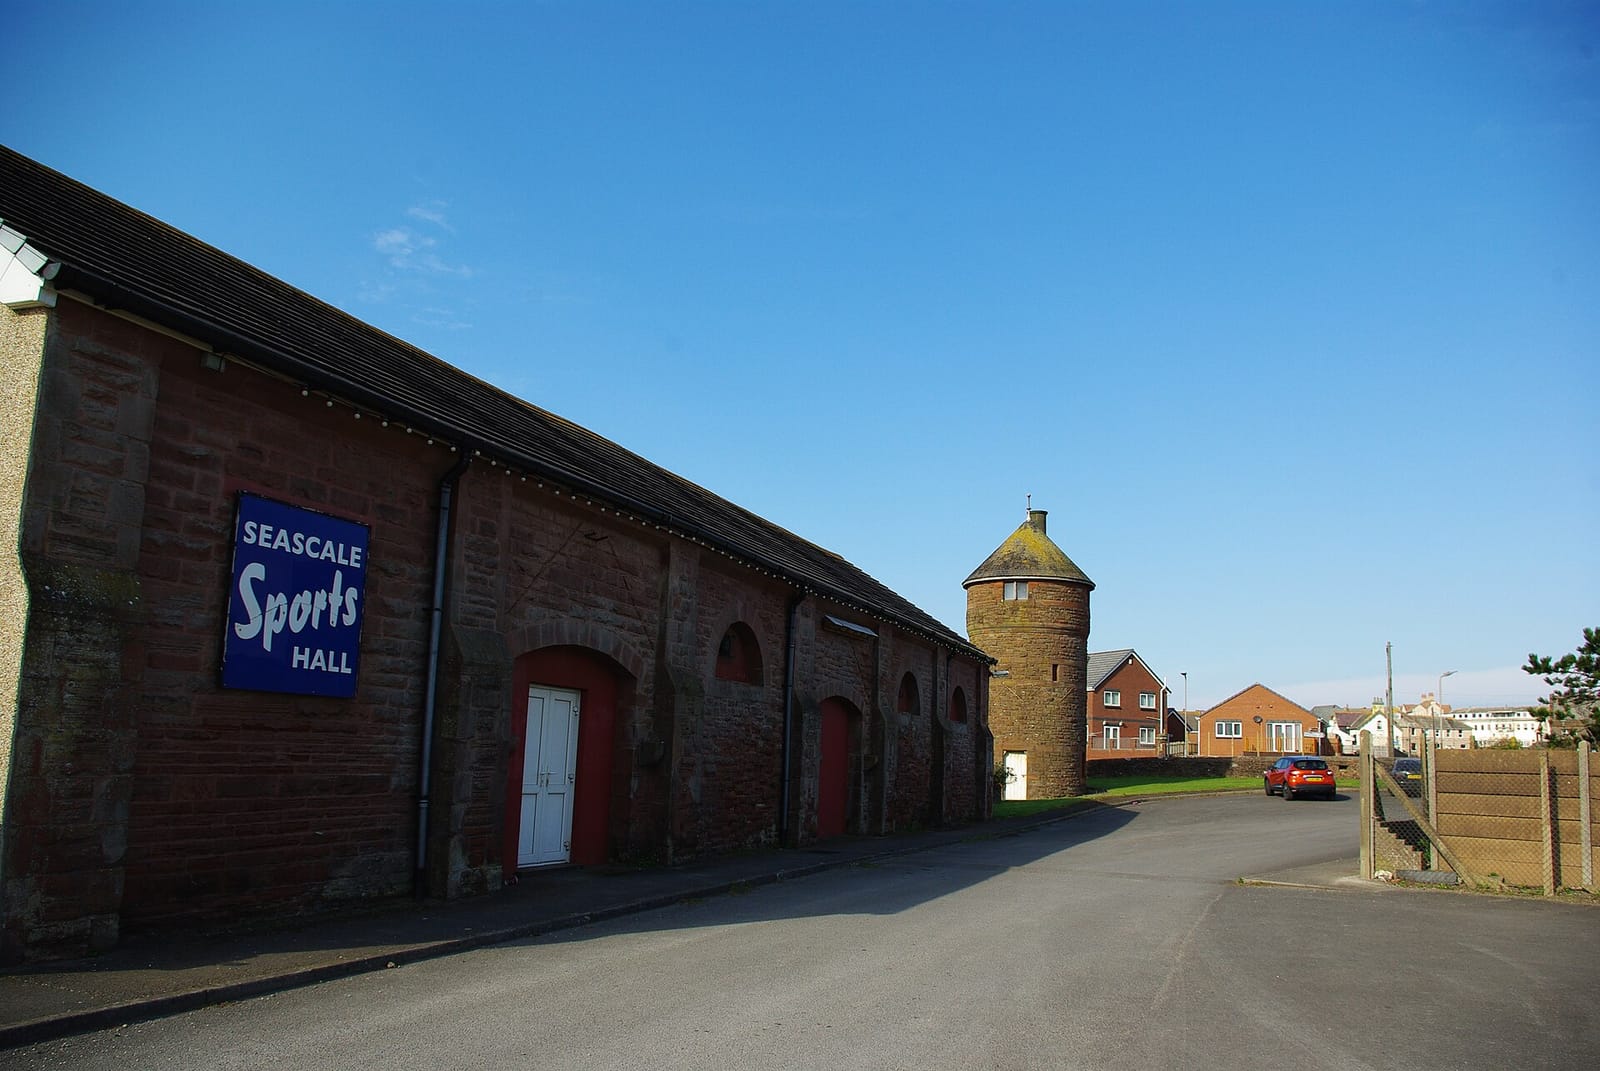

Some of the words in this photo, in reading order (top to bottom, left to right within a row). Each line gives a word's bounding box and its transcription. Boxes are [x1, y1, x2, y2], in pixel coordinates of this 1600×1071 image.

[243, 521, 362, 568] SEASCALE
[235, 562, 358, 652] Sports
[292, 646, 352, 674] HALL
